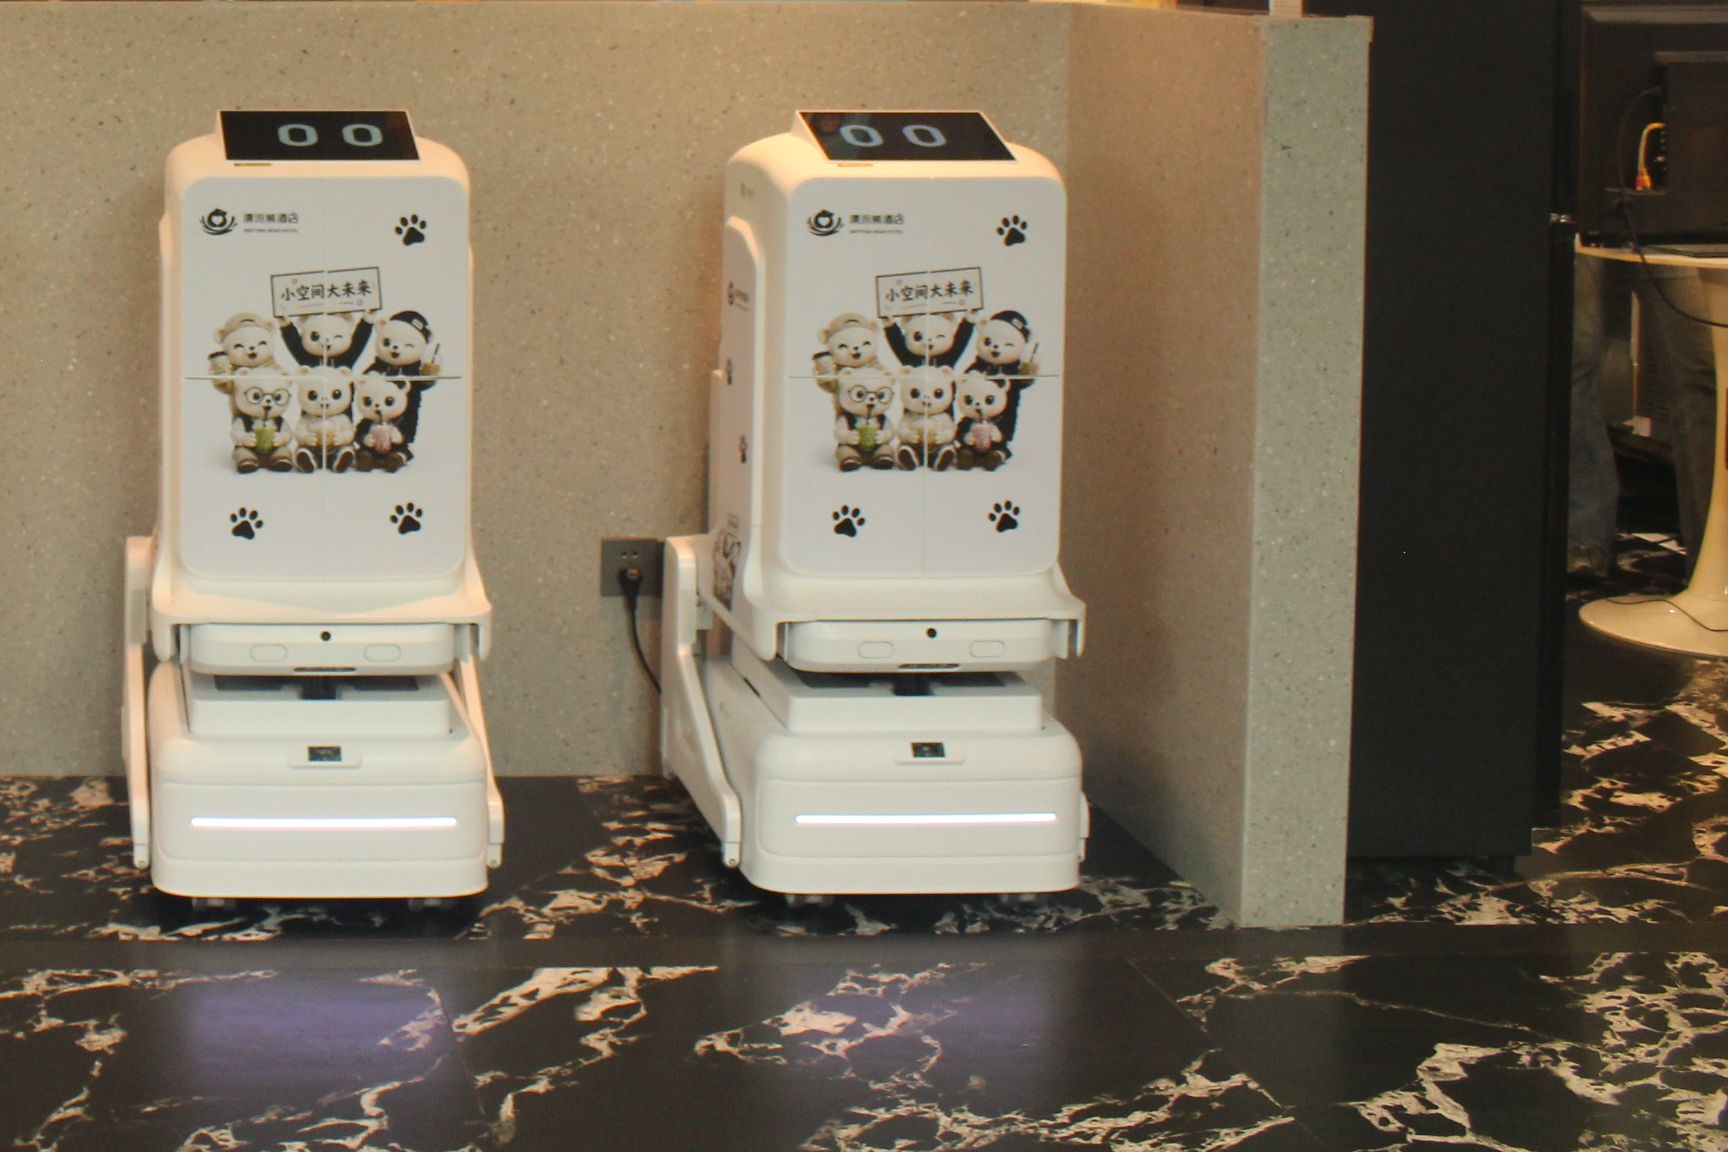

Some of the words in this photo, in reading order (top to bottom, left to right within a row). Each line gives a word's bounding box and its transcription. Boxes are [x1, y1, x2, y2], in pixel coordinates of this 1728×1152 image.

[281, 279, 372, 301] 小空间大未来
[885, 279, 974, 302] 小空间大未来
